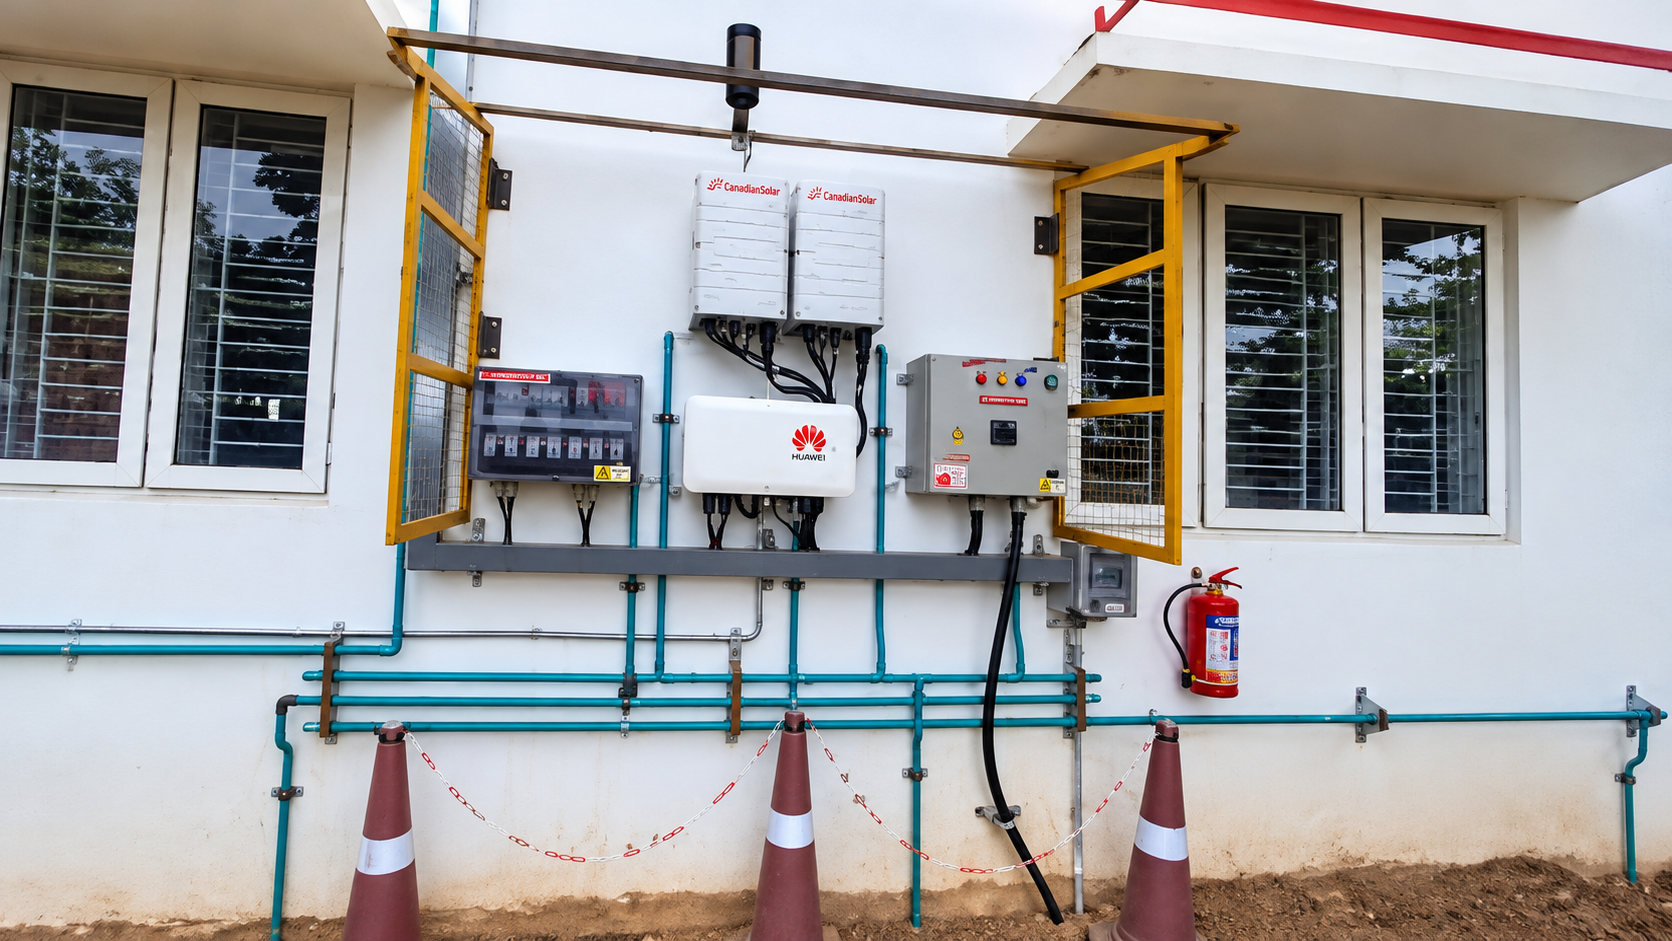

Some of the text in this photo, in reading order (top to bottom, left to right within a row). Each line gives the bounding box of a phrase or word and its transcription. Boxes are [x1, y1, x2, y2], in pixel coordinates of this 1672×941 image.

[724, 182, 780, 196] CanadianSolar
[823, 191, 877, 205] CanadianSolar
[791, 453, 825, 461] HUAWEI
